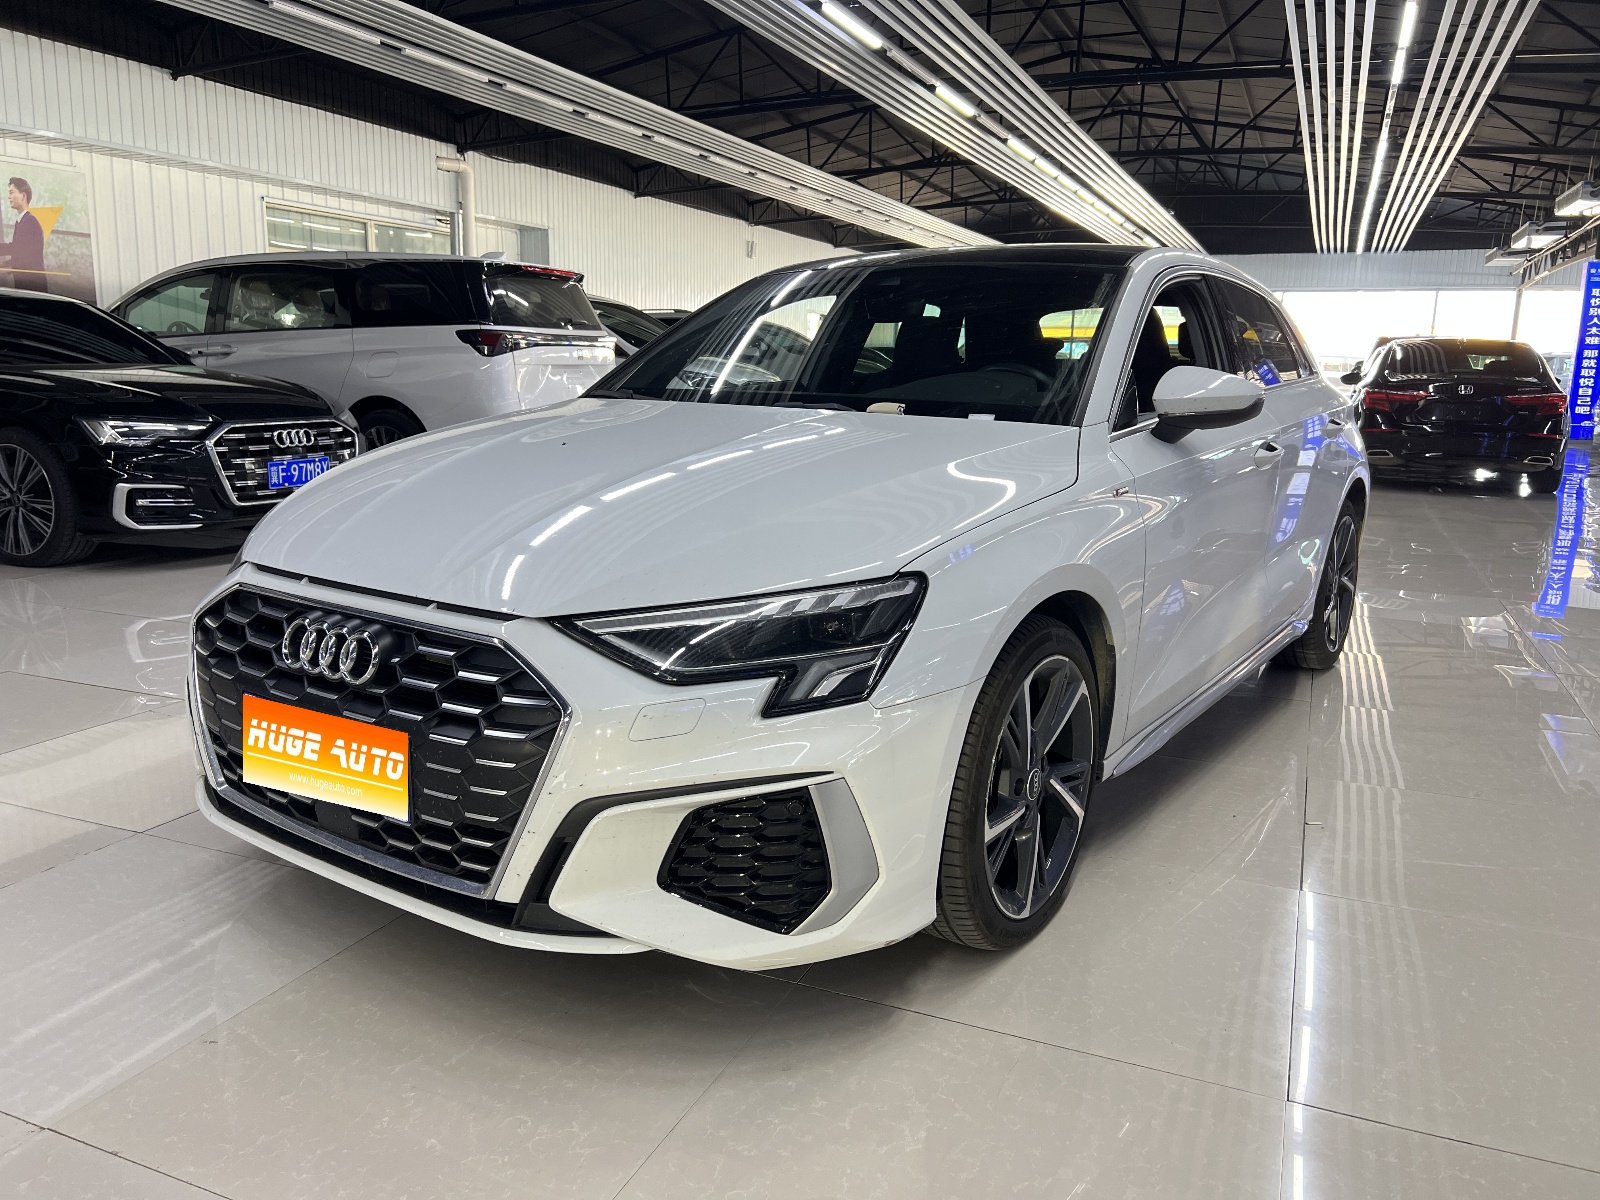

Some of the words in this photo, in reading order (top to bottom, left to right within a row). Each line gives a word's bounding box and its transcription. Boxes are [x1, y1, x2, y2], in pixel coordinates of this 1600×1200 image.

[1574, 349, 1599, 415] 那就取悦自己吧
